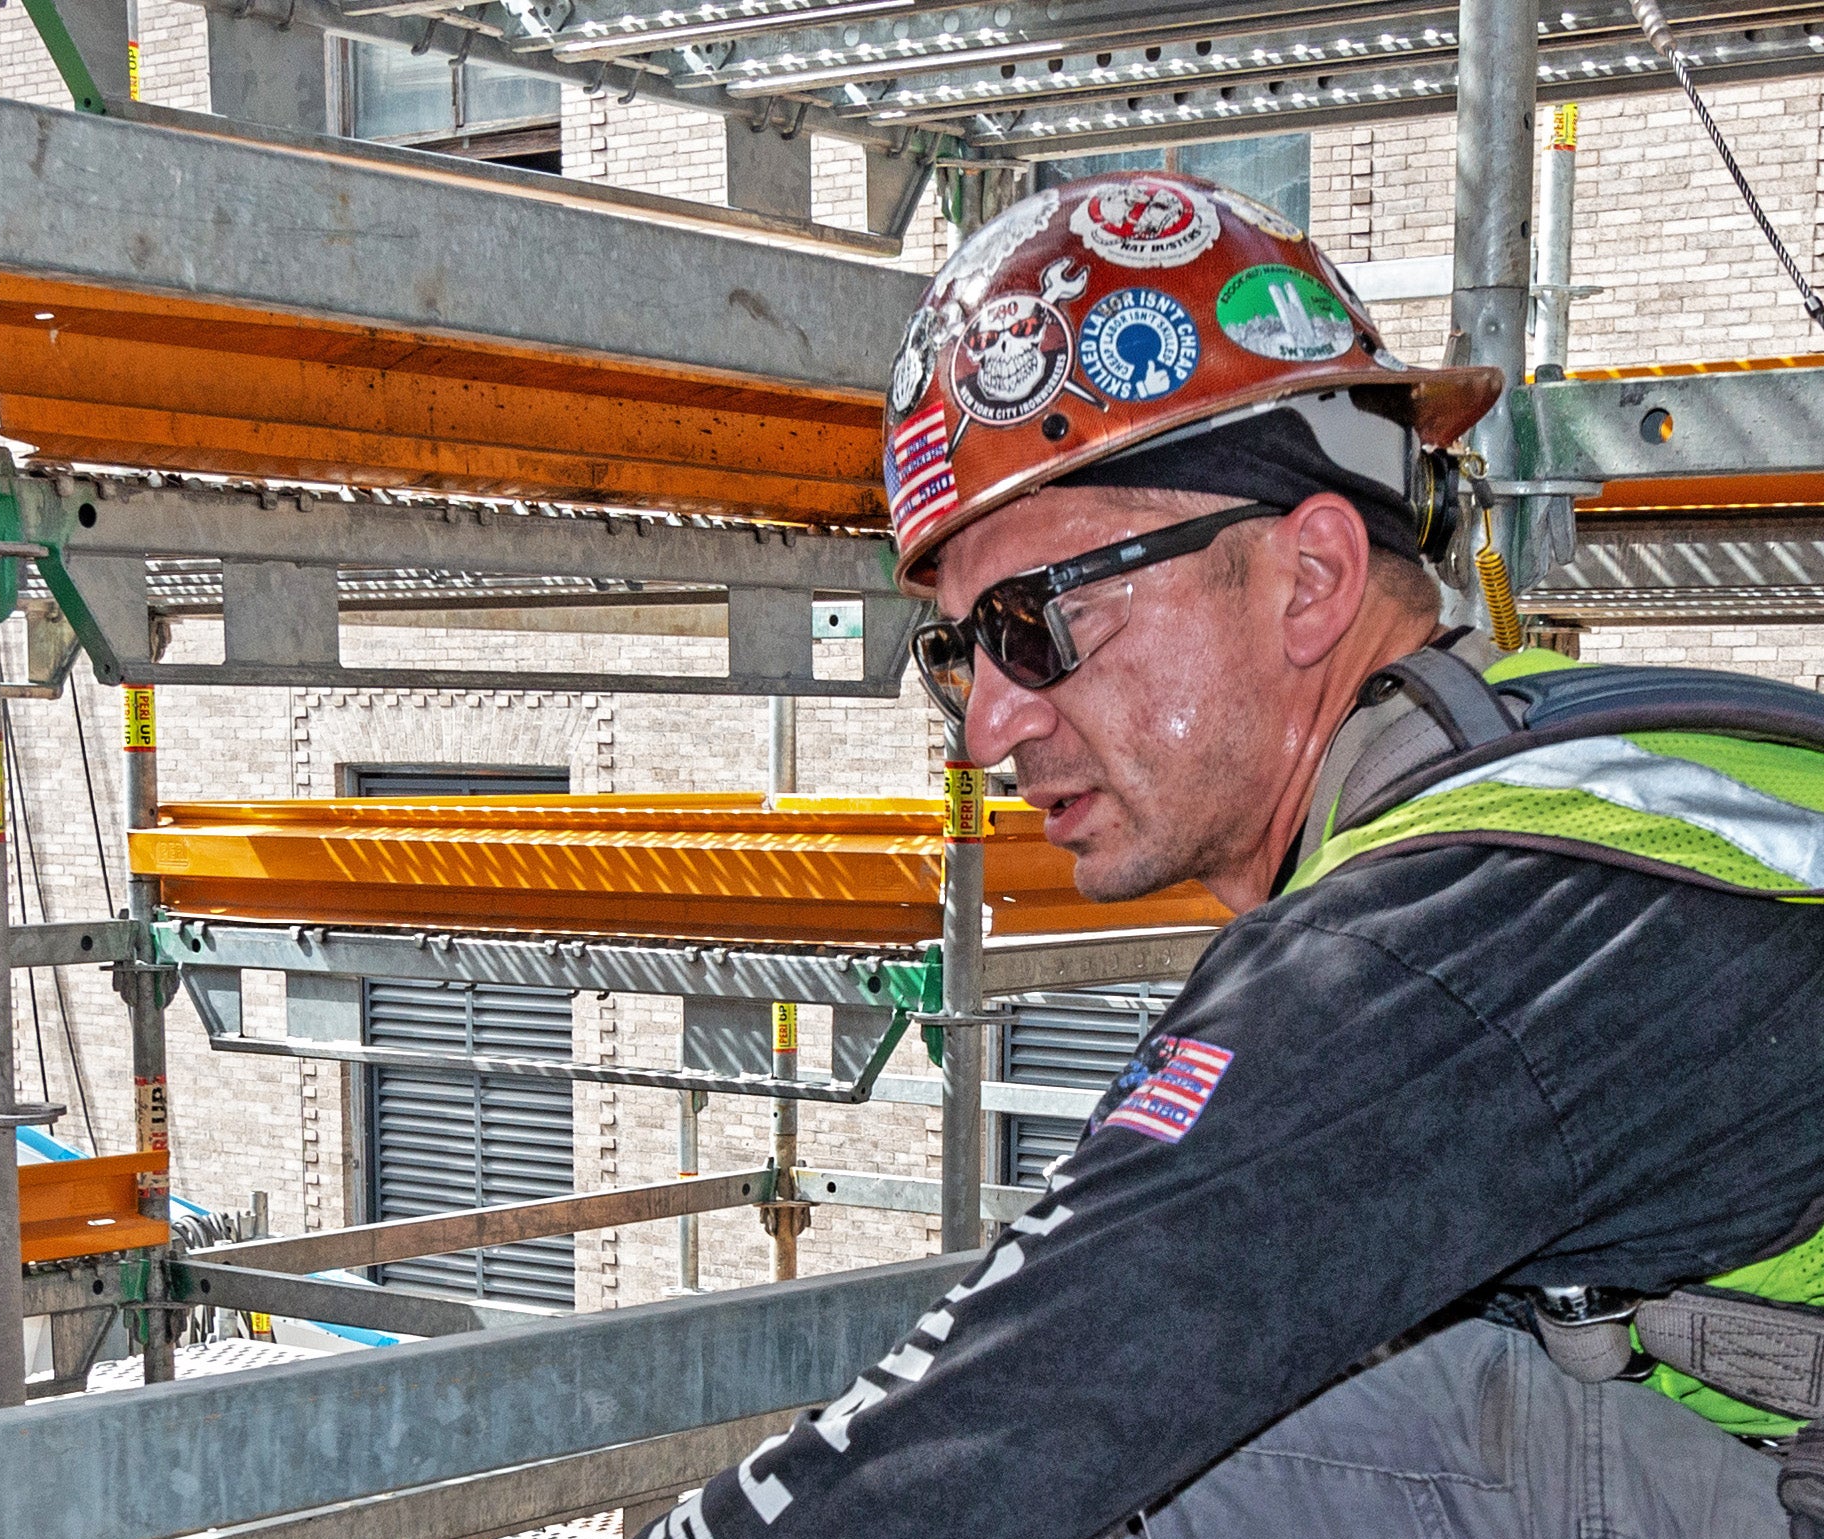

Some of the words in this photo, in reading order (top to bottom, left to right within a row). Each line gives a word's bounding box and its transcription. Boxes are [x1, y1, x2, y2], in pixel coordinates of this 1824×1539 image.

[987, 301, 1019, 323] 580
[1083, 291, 1135, 336] LABOR
[1140, 291, 1185, 322] ISN'T
[1173, 323, 1197, 380] CHEAP
[1080, 340, 1132, 399] SKILLED
[959, 385, 975, 407] NEW
[973, 400, 994, 419] YORK
[995, 407, 1017, 420] CITY
[1019, 353, 1067, 414] IRONWORKERS
[919, 472, 951, 503] 580
[139, 695, 150, 720] PERI
[140, 724, 151, 745] UP
[960, 770, 974, 795] UP
[960, 800, 974, 830] PERI
[778, 1005, 788, 1021] UP
[779, 1024, 788, 1044] PERI
[152, 1087, 168, 1124] UP
[1147, 1099, 1189, 1124] 580
